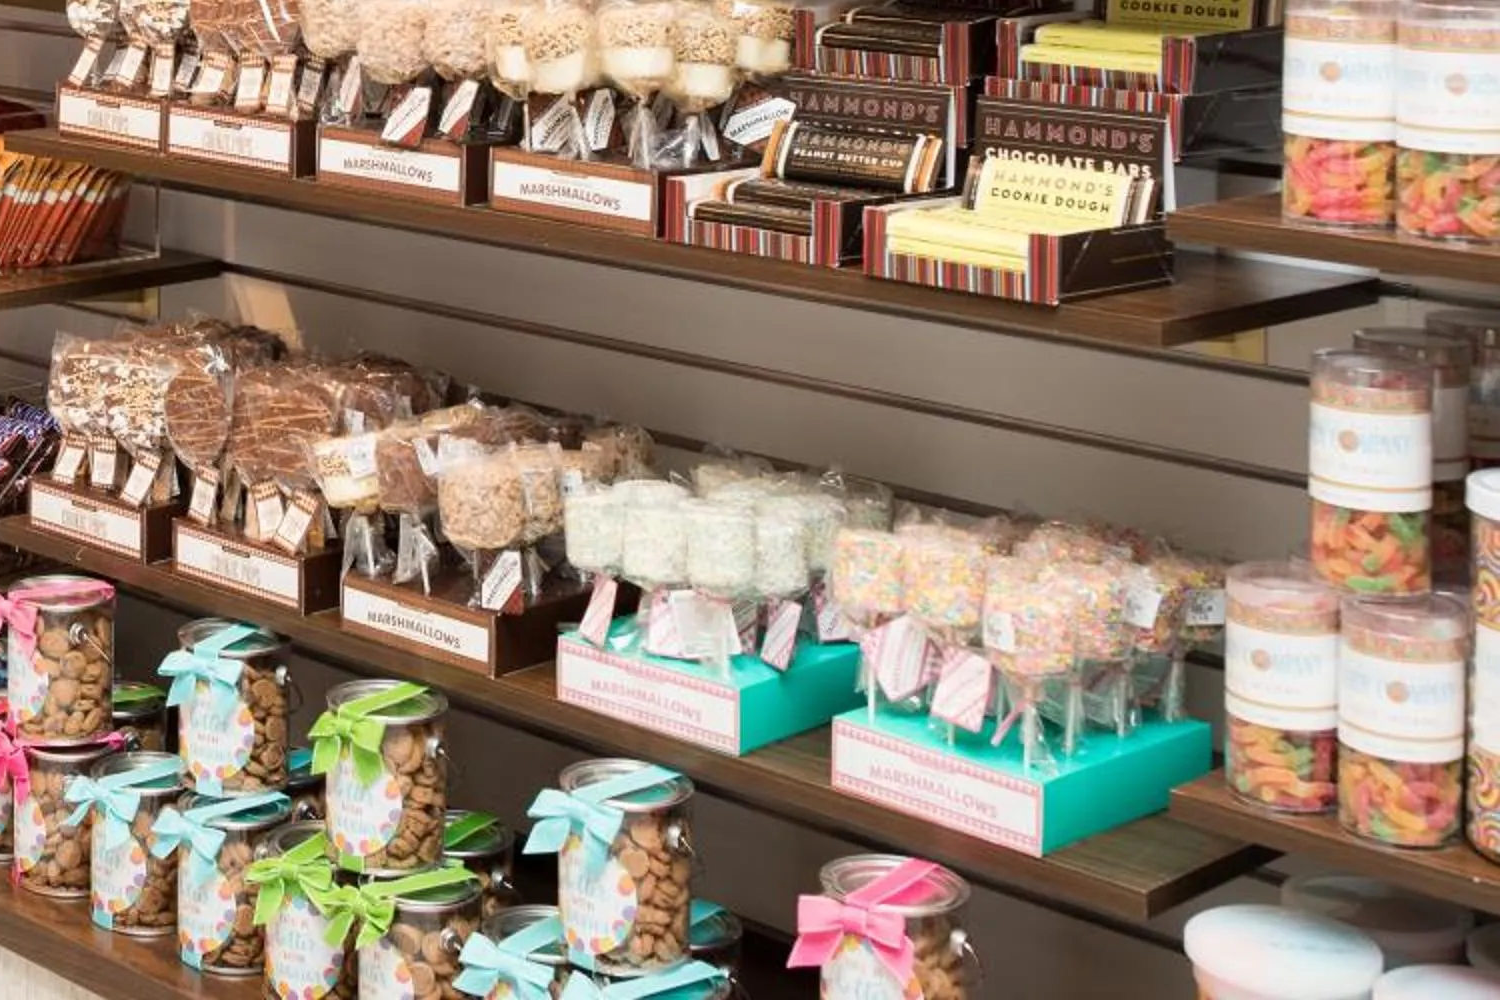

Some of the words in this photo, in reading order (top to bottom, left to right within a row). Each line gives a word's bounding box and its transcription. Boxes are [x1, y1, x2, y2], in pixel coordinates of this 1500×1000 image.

[1119, 0, 1179, 14] COOKIE
[1182, 4, 1240, 19] DOUGH
[790, 91, 940, 122] HAMMOND'S
[984, 117, 1155, 153] HAMMOND'S
[343, 158, 433, 183] MARSHMALLOWS
[793, 148, 836, 160] PEANUT
[837, 153, 880, 166] BUTTER
[881, 158, 903, 168] CUP
[985, 147, 1103, 171] CHOCOLATE
[1107, 160, 1153, 178] BARS
[519, 184, 621, 211] MARSHMALLOWS
[993, 170, 1114, 196] HAMMOND'S
[991, 187, 1050, 202] COOKIE
[1054, 194, 1110, 214] DOUGH
[367, 610, 461, 649] MARSHMALLOWS
[591, 679, 703, 723] MARSHMALLOWS
[869, 765, 998, 819] MARSHMALLOWS
